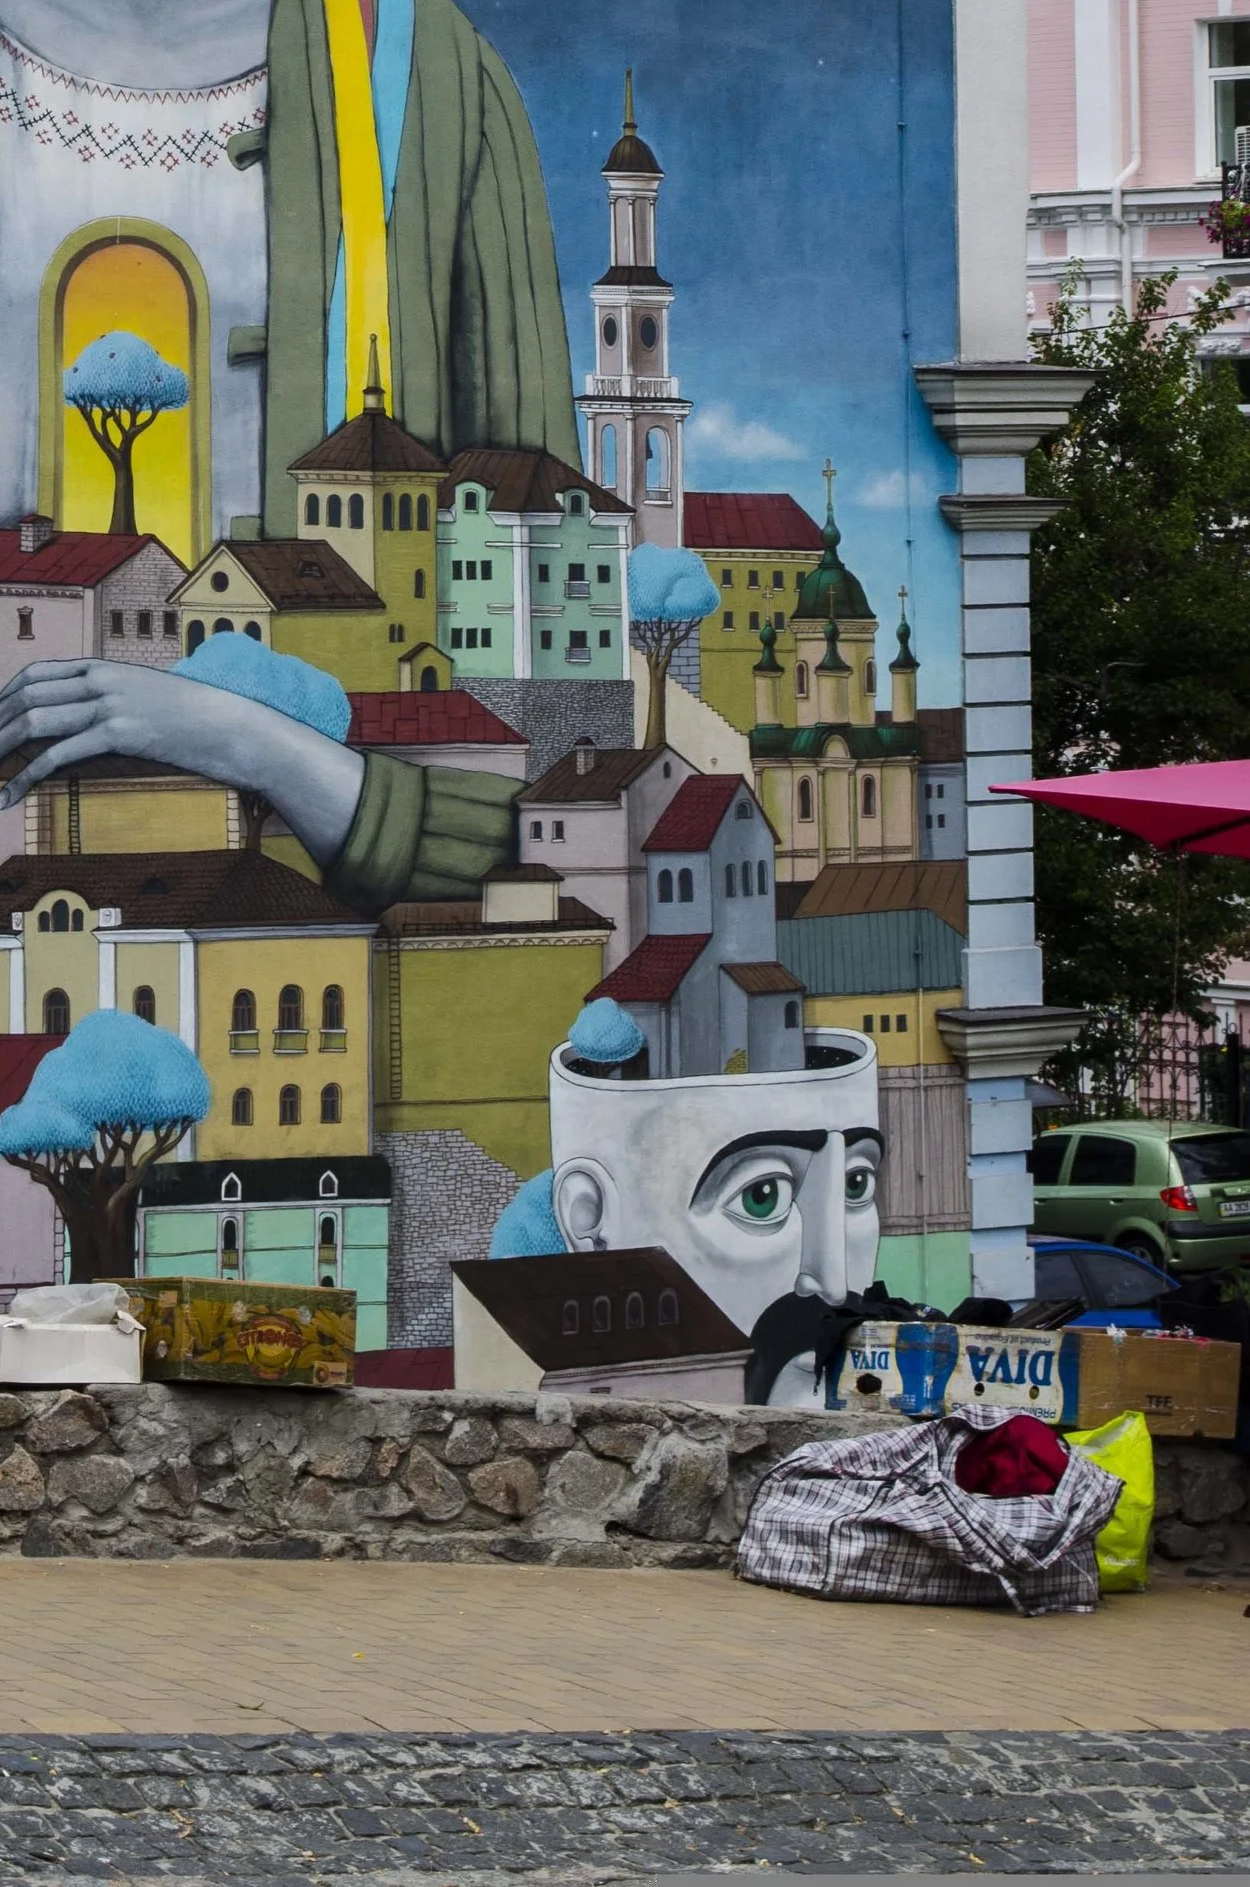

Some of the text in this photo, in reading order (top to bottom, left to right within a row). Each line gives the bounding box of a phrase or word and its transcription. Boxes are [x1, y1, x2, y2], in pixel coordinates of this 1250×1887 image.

[1010, 1335, 1019, 1345] of
[1020, 1336, 1052, 1346] Product
[850, 1349, 890, 1370] DIVA
[966, 1345, 1054, 1386] DIVA
